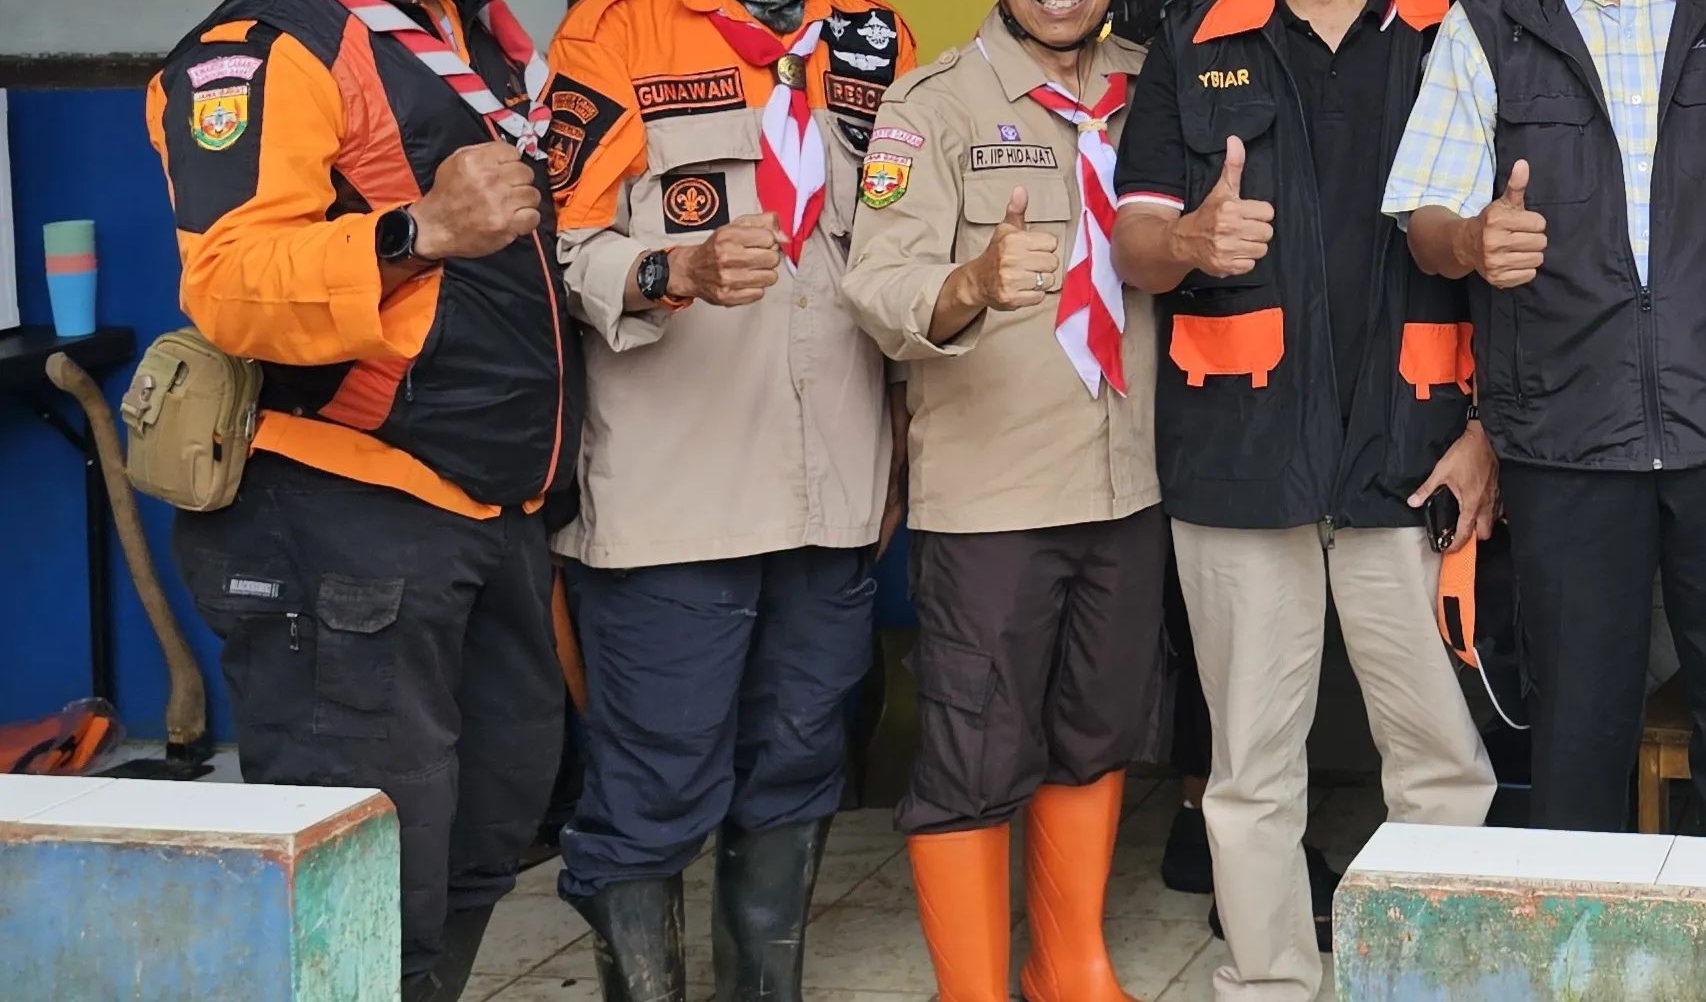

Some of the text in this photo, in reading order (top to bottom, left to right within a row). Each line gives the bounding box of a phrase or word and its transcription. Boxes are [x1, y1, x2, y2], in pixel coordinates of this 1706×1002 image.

[638, 78, 735, 106] GUNAWAN
[833, 82, 881, 108] RESC
[976, 148, 1052, 166] R. IIP HIDAJAT
